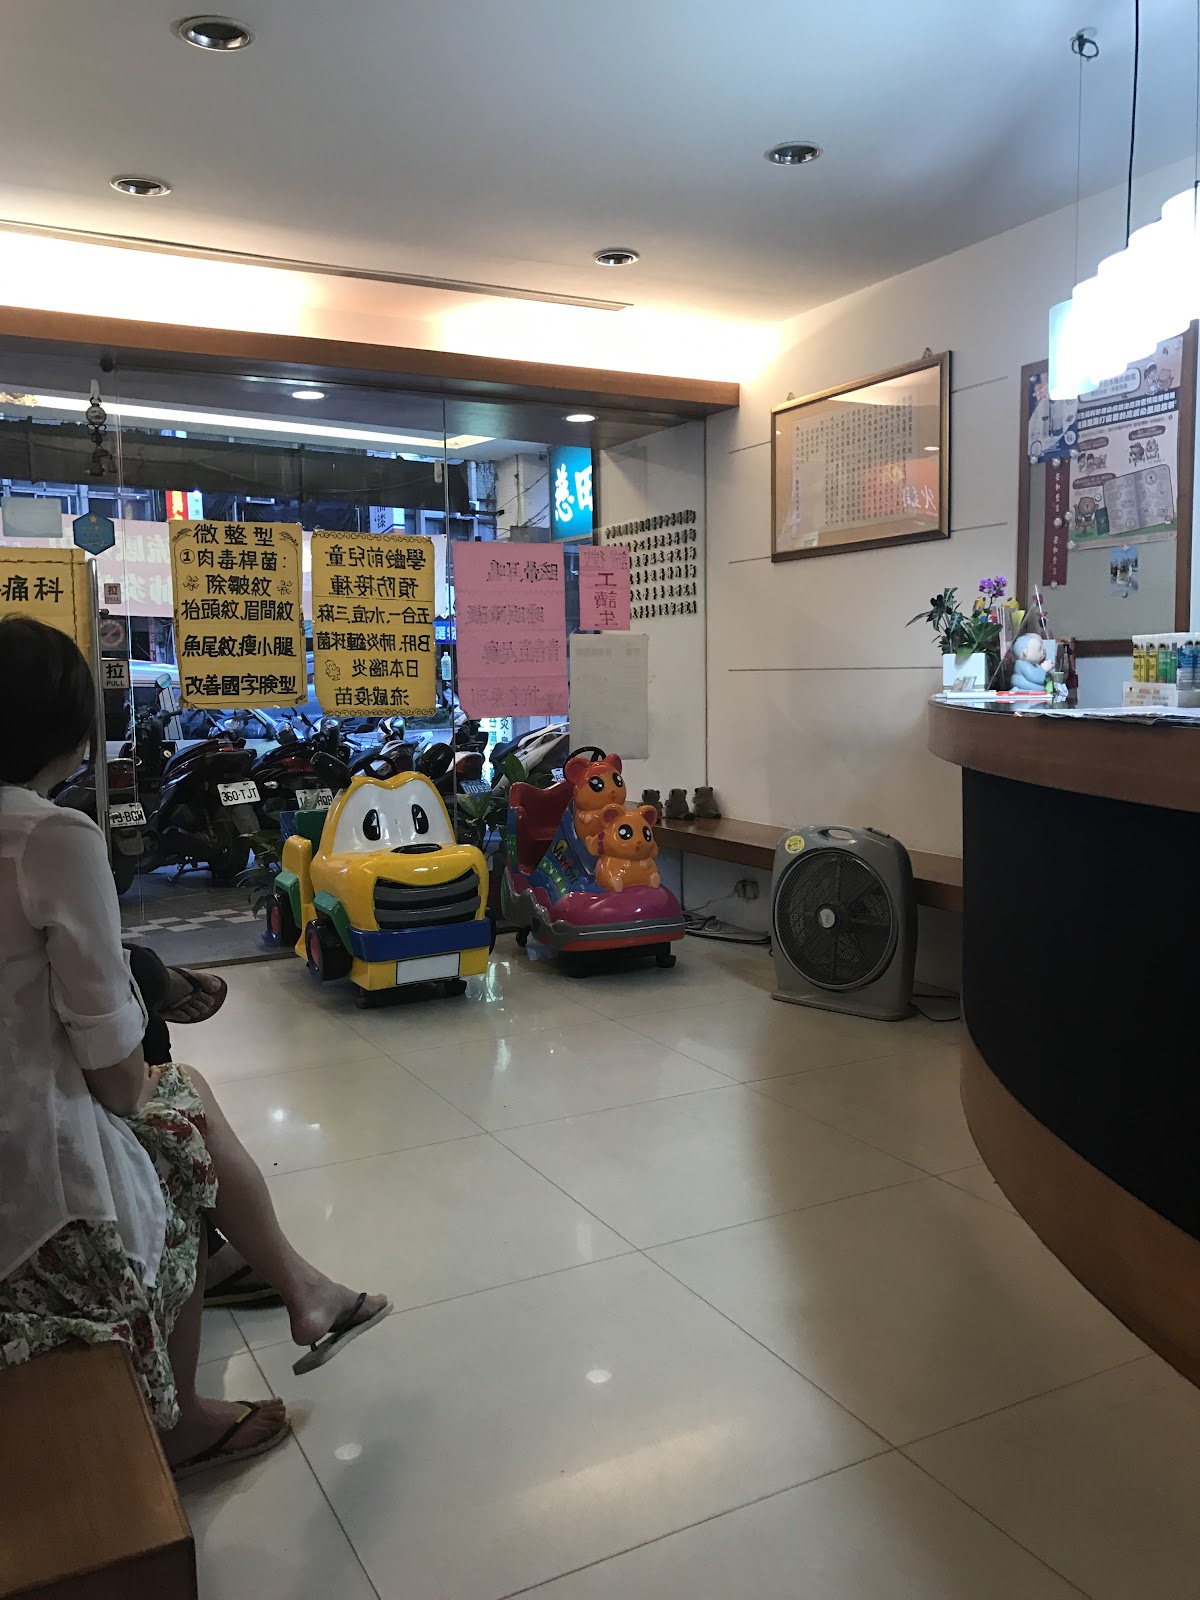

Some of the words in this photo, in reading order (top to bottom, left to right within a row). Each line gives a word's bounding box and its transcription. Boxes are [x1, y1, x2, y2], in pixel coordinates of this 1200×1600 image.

[193, 523, 275, 547] 微整型
[107, 585, 119, 596] 拉
[206, 574, 272, 597] 除皺紋
[106, 663, 125, 679] 拉
